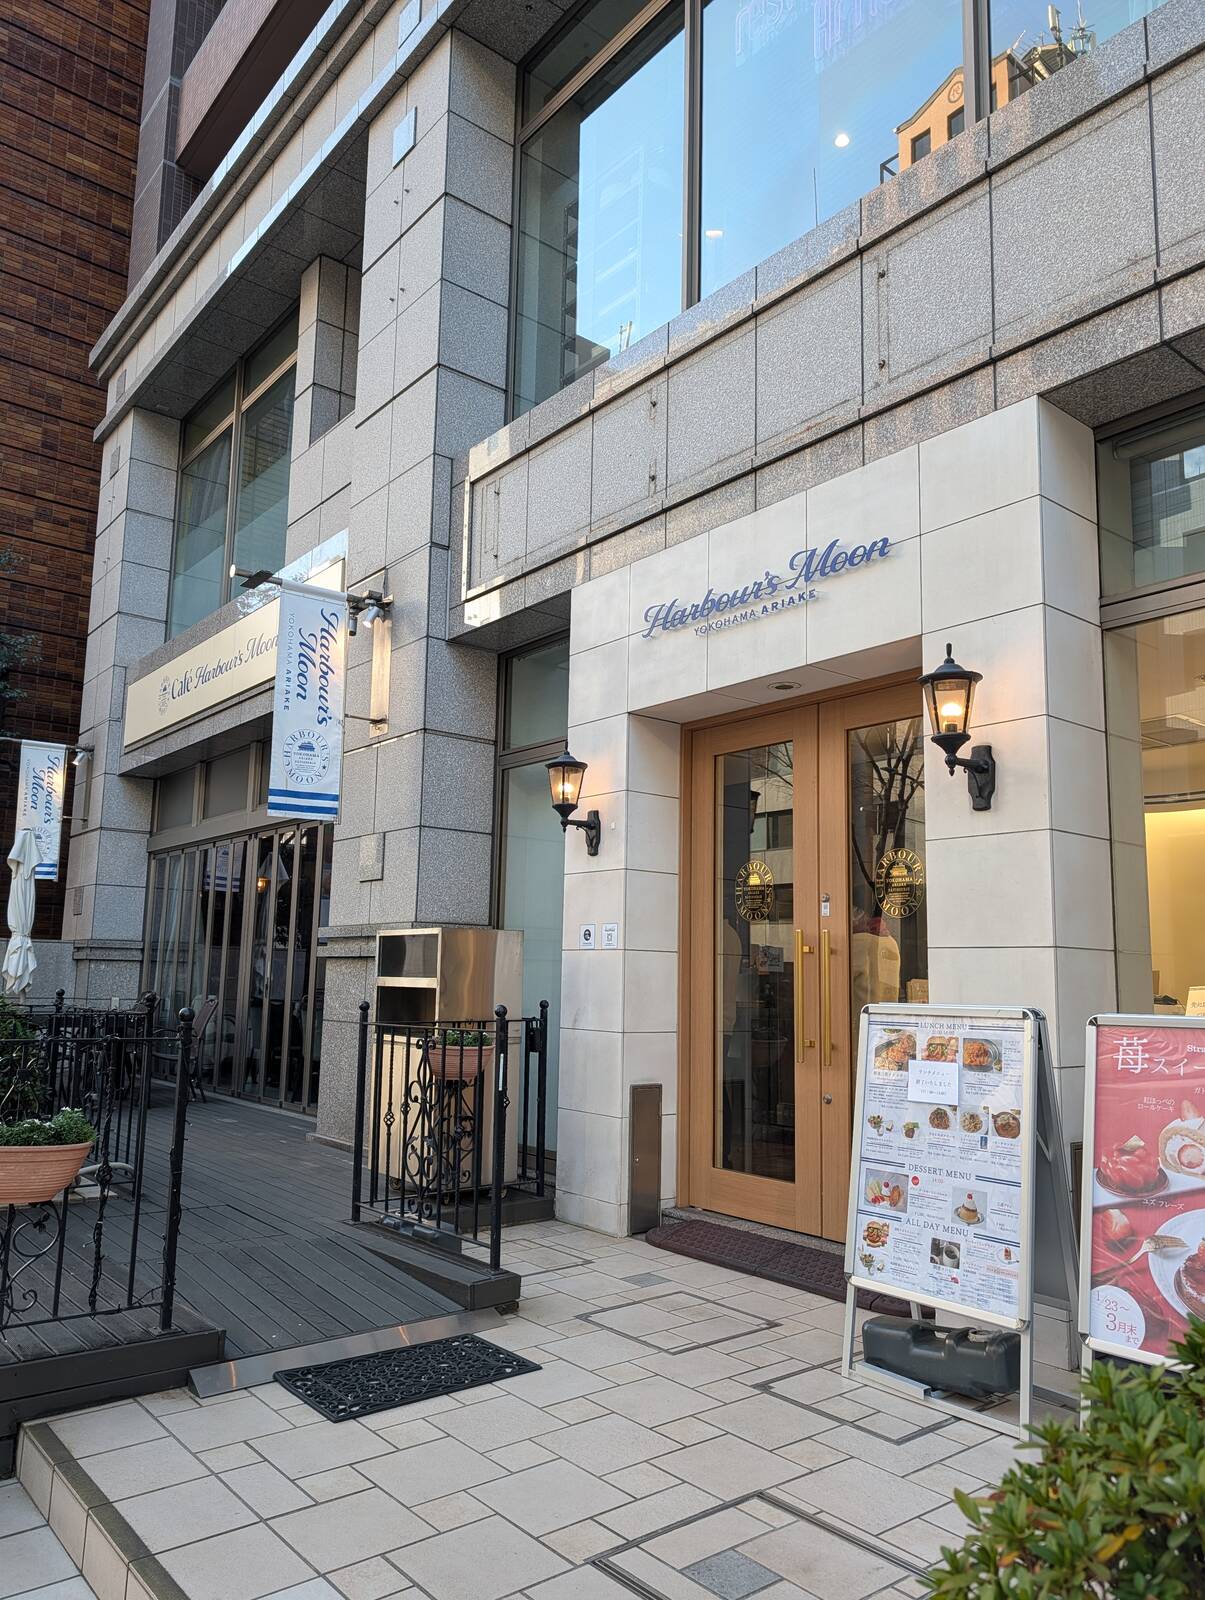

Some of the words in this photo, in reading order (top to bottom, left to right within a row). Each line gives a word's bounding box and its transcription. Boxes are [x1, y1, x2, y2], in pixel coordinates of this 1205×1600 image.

[641, 570, 782, 639] Harbour's
[786, 536, 890, 591] Moon
[694, 609, 757, 637] YOKOHAMA
[761, 588, 817, 615] ARIAKE
[286, 612, 296, 665] YOKOHAMA
[171, 669, 193, 700] Café
[194, 650, 243, 689] Harbour's
[296, 627, 318, 701] Moon
[317, 608, 339, 727] Harbour's
[283, 669, 292, 711] ARIAKE
[30, 767, 46, 810] Moon
[44, 753, 61, 825] Harbour's
[920, 1022, 945, 1030] LUNCH
[946, 1023, 968, 1031] MENU
[908, 1163, 943, 1176] DESSERT
[945, 1170, 972, 1181] MENU
[905, 1217, 921, 1227] ALL
[923, 1221, 940, 1231] DAY
[942, 1224, 969, 1237] MENU
[1105, 1312, 1137, 1336] 3月末
